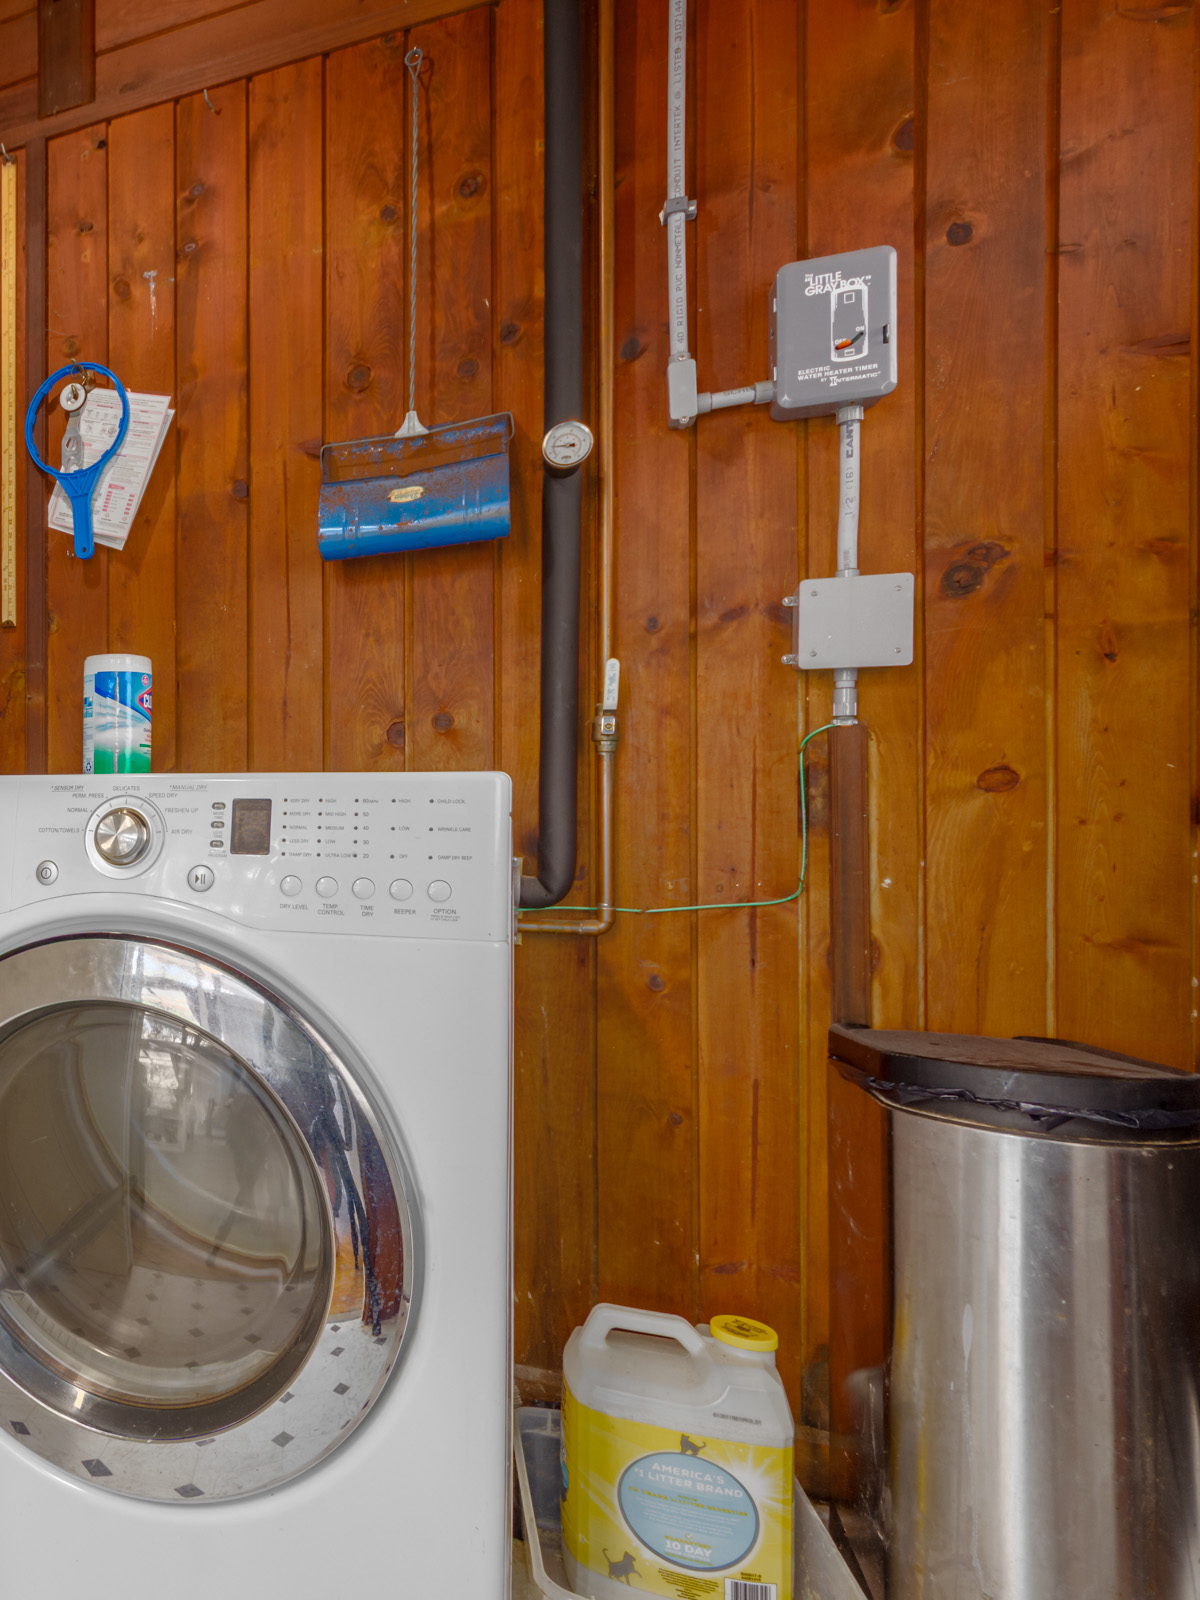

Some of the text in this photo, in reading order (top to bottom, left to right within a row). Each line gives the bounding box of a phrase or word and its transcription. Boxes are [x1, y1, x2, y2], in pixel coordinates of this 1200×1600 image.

[673, 47, 682, 84] LISTED
[673, 105, 682, 151] INTERTEK
[673, 216, 682, 268] NONMETALL
[674, 274, 683, 292] PVC
[804, 282, 838, 297] GRAY
[675, 297, 684, 327] RIGID
[797, 365, 831, 375] ELECTRIC
[797, 363, 879, 381] WATER HEATER TIMER
[845, 422, 854, 459] CANT
[647, 1471, 692, 1489] LITTER
[696, 1483, 743, 1498] BRAND
[651, 1463, 725, 1485] AMERICA'S
[664, 1540, 681, 1551] 10
[684, 1544, 713, 1558] DAY
